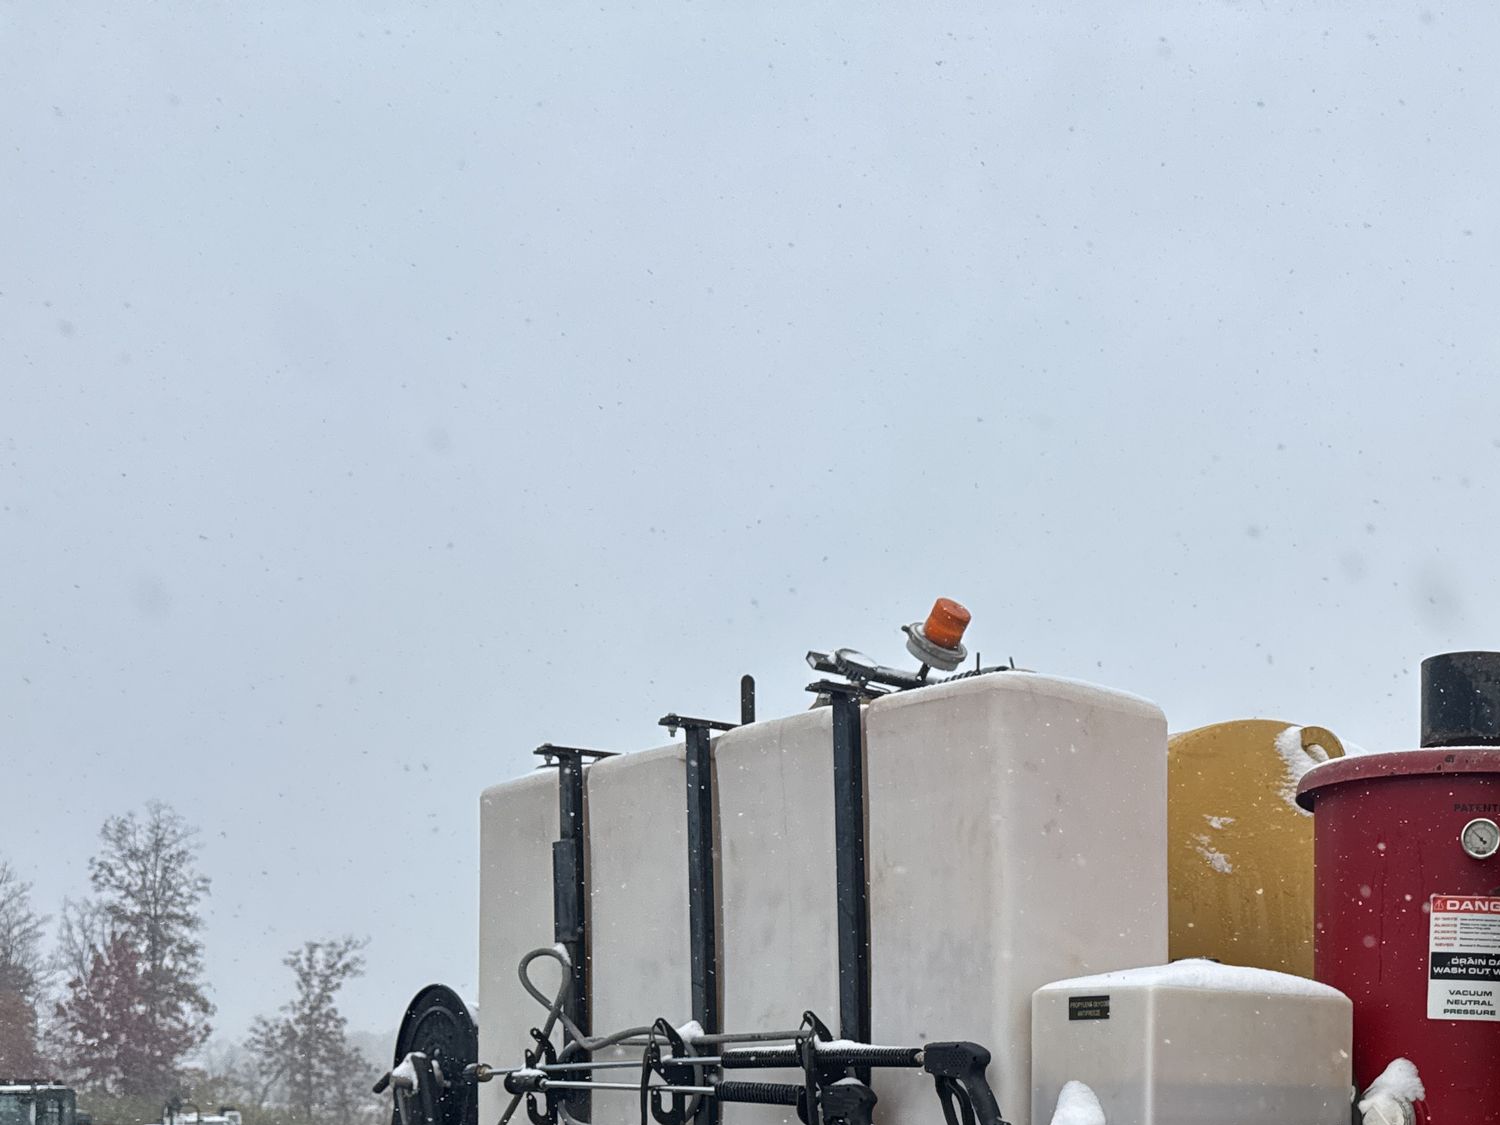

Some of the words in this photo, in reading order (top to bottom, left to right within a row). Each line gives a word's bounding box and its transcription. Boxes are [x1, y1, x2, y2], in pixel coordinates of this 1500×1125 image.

[1451, 957, 1486, 966] DRAIN
[1433, 966, 1466, 974] WASH
[1468, 967, 1492, 975] OUT
[1449, 989, 1493, 997] VACUUM
[1446, 999, 1494, 1007] NEUTRAL
[1443, 1008, 1497, 1016] PRESSURE
